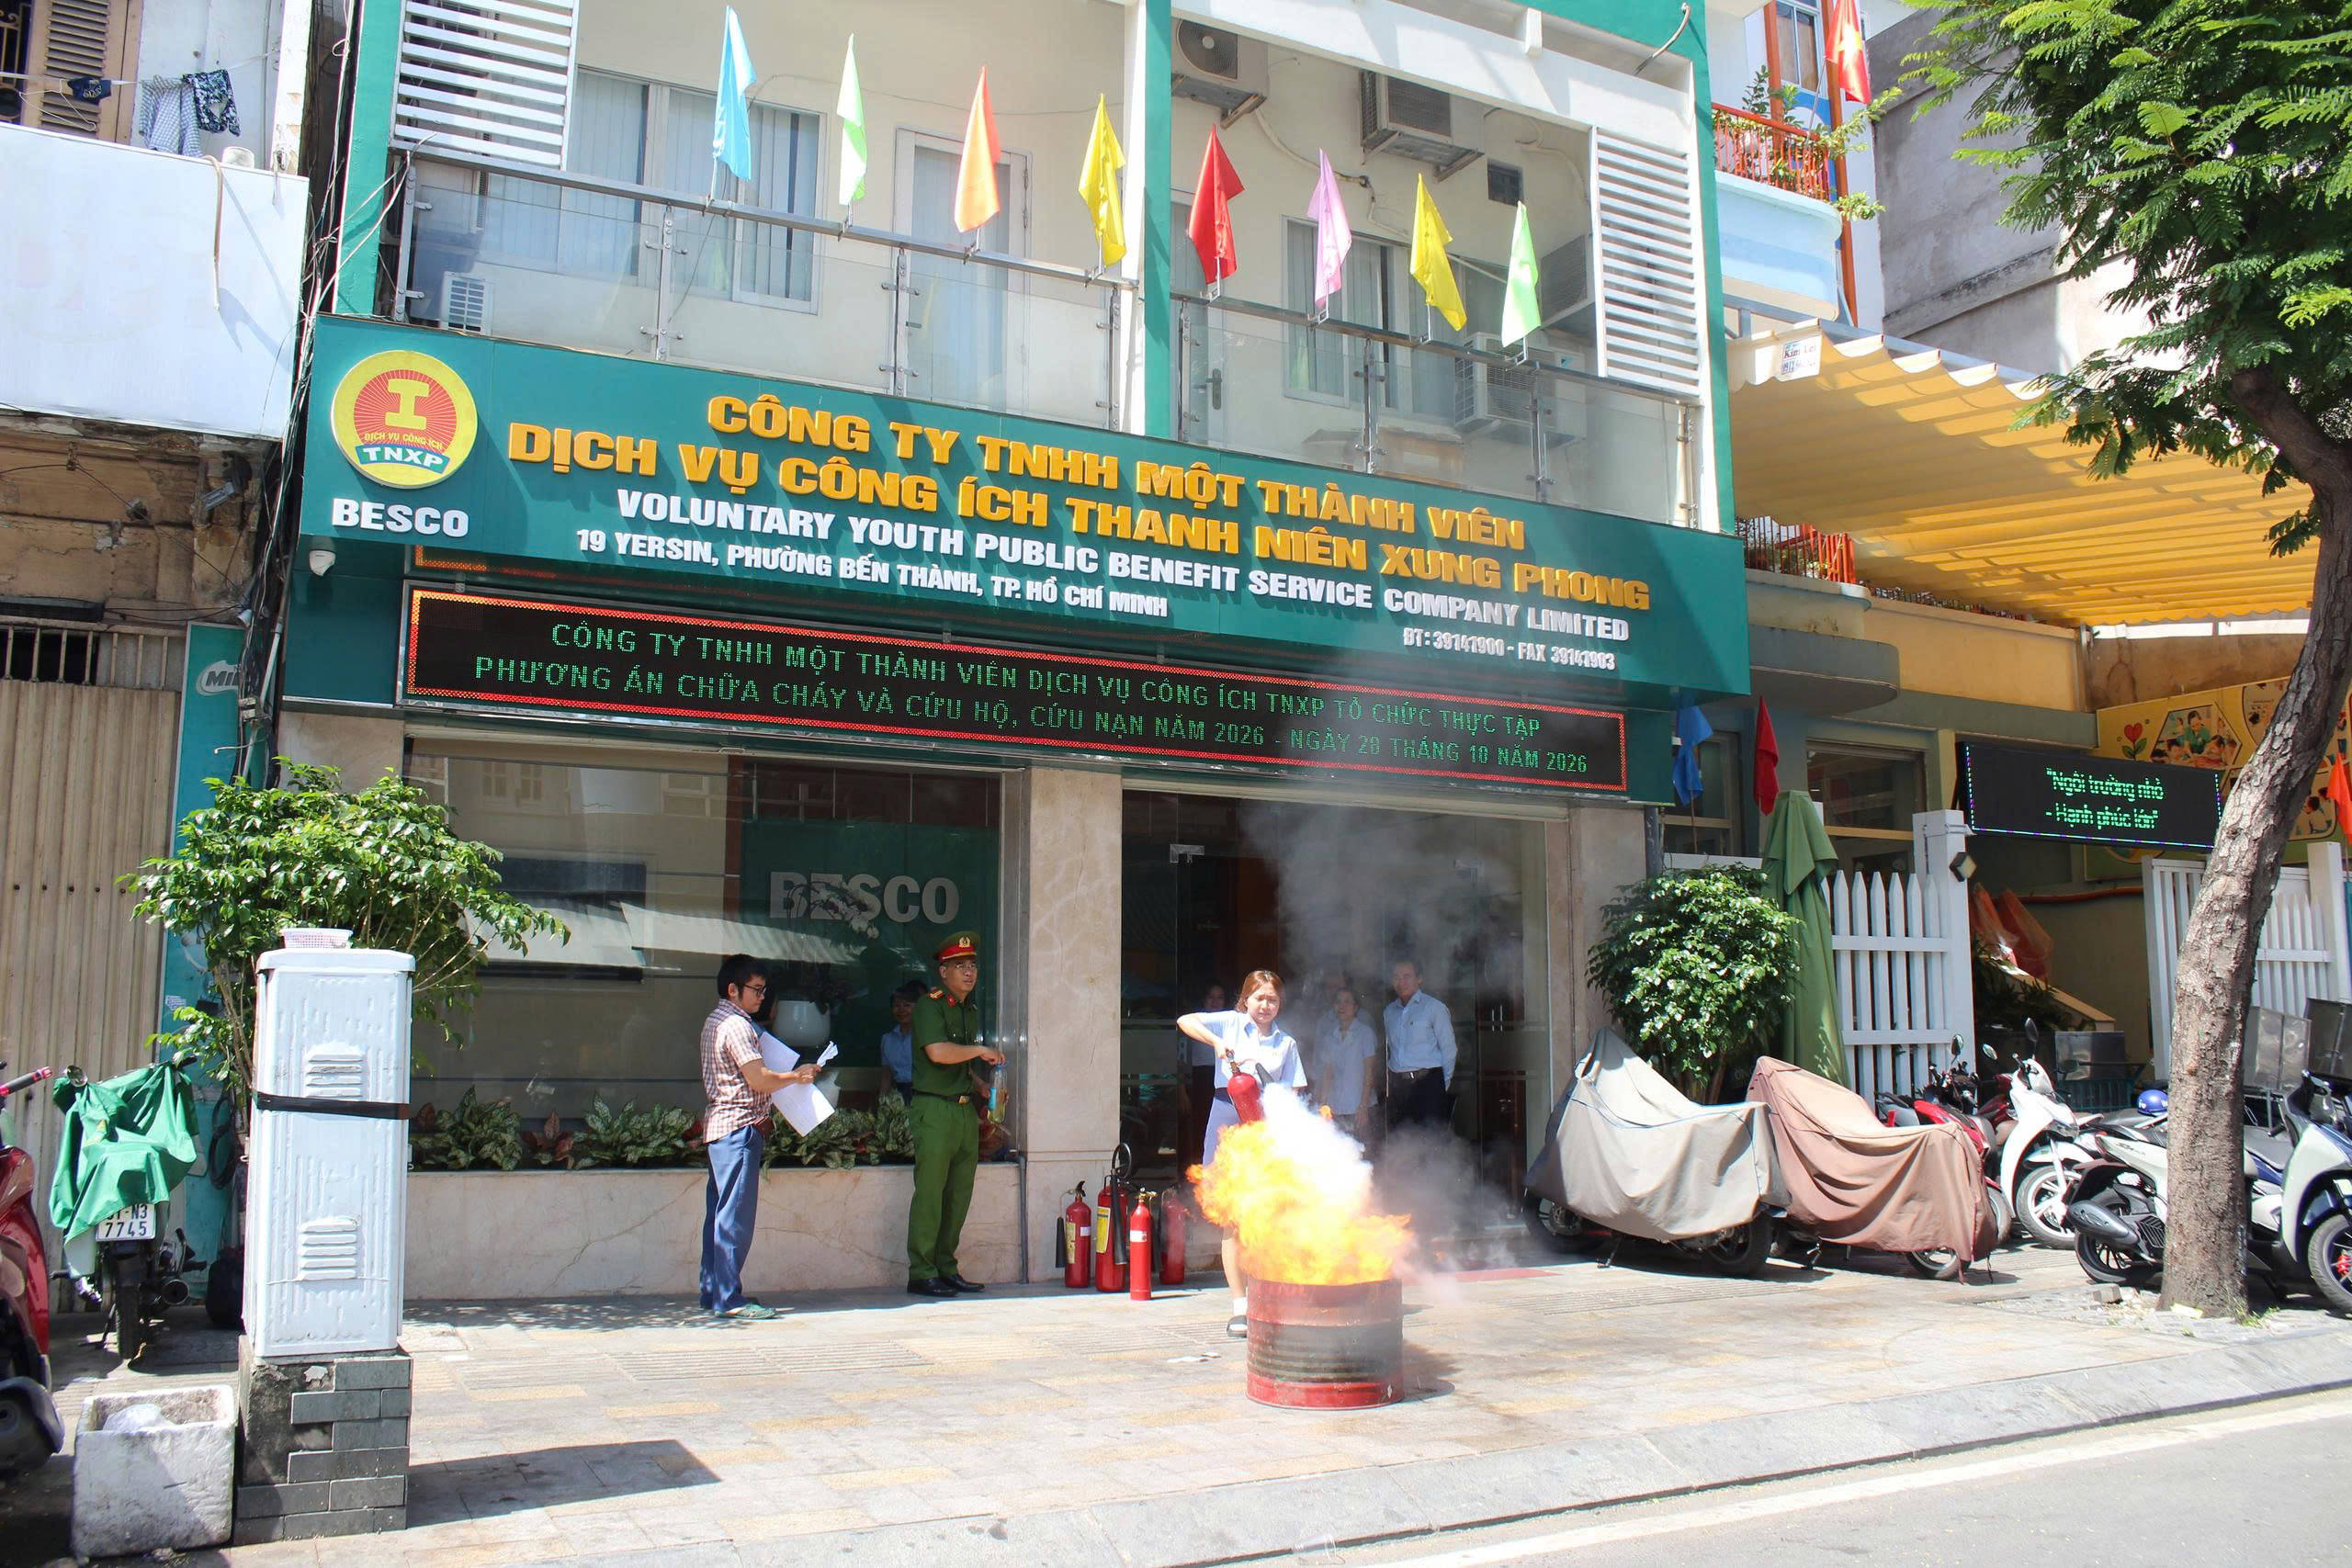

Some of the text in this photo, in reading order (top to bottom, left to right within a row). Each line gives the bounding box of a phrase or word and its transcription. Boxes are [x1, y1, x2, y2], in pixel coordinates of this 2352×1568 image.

[362, 446, 444, 468] TNXP
[709, 395, 1525, 549] CÔNG TY TNHH MỘT THÀNH VIÊN
[332, 498, 469, 537] BESCO
[510, 423, 1650, 610] DỊCH VỤ CÔNG ÍCH THANH NIÊN XUNG PHONG
[576, 528, 1168, 618] 19 YERSIN, PHƯỜNG BẾN THÀNH, TP. HỒ CHÍ MINH
[616, 489, 1630, 641] VOLUNTARY YOUTH PUBLIC BENEFIT SERVICE COMPANY LIMITED
[551, 621, 636, 653] CÔNG
[649, 632, 685, 657] TY
[696, 637, 772, 664] TNHH
[786, 645, 846, 676] MỘT
[856, 650, 945, 682] THÀNH
[956, 660, 1016, 688] VIÊN
[1028, 668, 1087, 696] DỊCH
[1098, 675, 1131, 705] VỤ
[1141, 678, 1208, 706] CÔNG
[1218, 682, 1256, 711] ÍCH
[1265, 692, 1324, 717] TNXP
[1372, 700, 1432, 728] CHỨC
[1439, 709, 1496, 737] THỰC
[1501, 714, 1541, 740] TẬP
[1432, 631, 1505, 657] 39141900
[1518, 641, 1546, 662] FAX
[1550, 646, 1616, 671] 39141903
[475, 655, 611, 691] PHƯƠNG
[623, 664, 663, 694] ÁN
[677, 672, 760, 703] CHỮA
[772, 680, 847, 710] CHÁY
[856, 687, 894, 715] VÀ
[906, 691, 962, 720] CỨU
[974, 698, 1018, 729] HỘ,
[1029, 702, 1084, 730] CỨU
[1094, 711, 1143, 739] NẠN
[1154, 713, 1205, 740] NĂM
[1214, 722, 1265, 746] 2026
[1289, 727, 1351, 752] NGÀY
[1389, 735, 1460, 764] THÁNG
[1497, 744, 1540, 769] NĂM
[1545, 750, 1588, 773] 2026
[769, 872, 960, 925] BESCO
[105, 1221, 148, 1238] 7745
